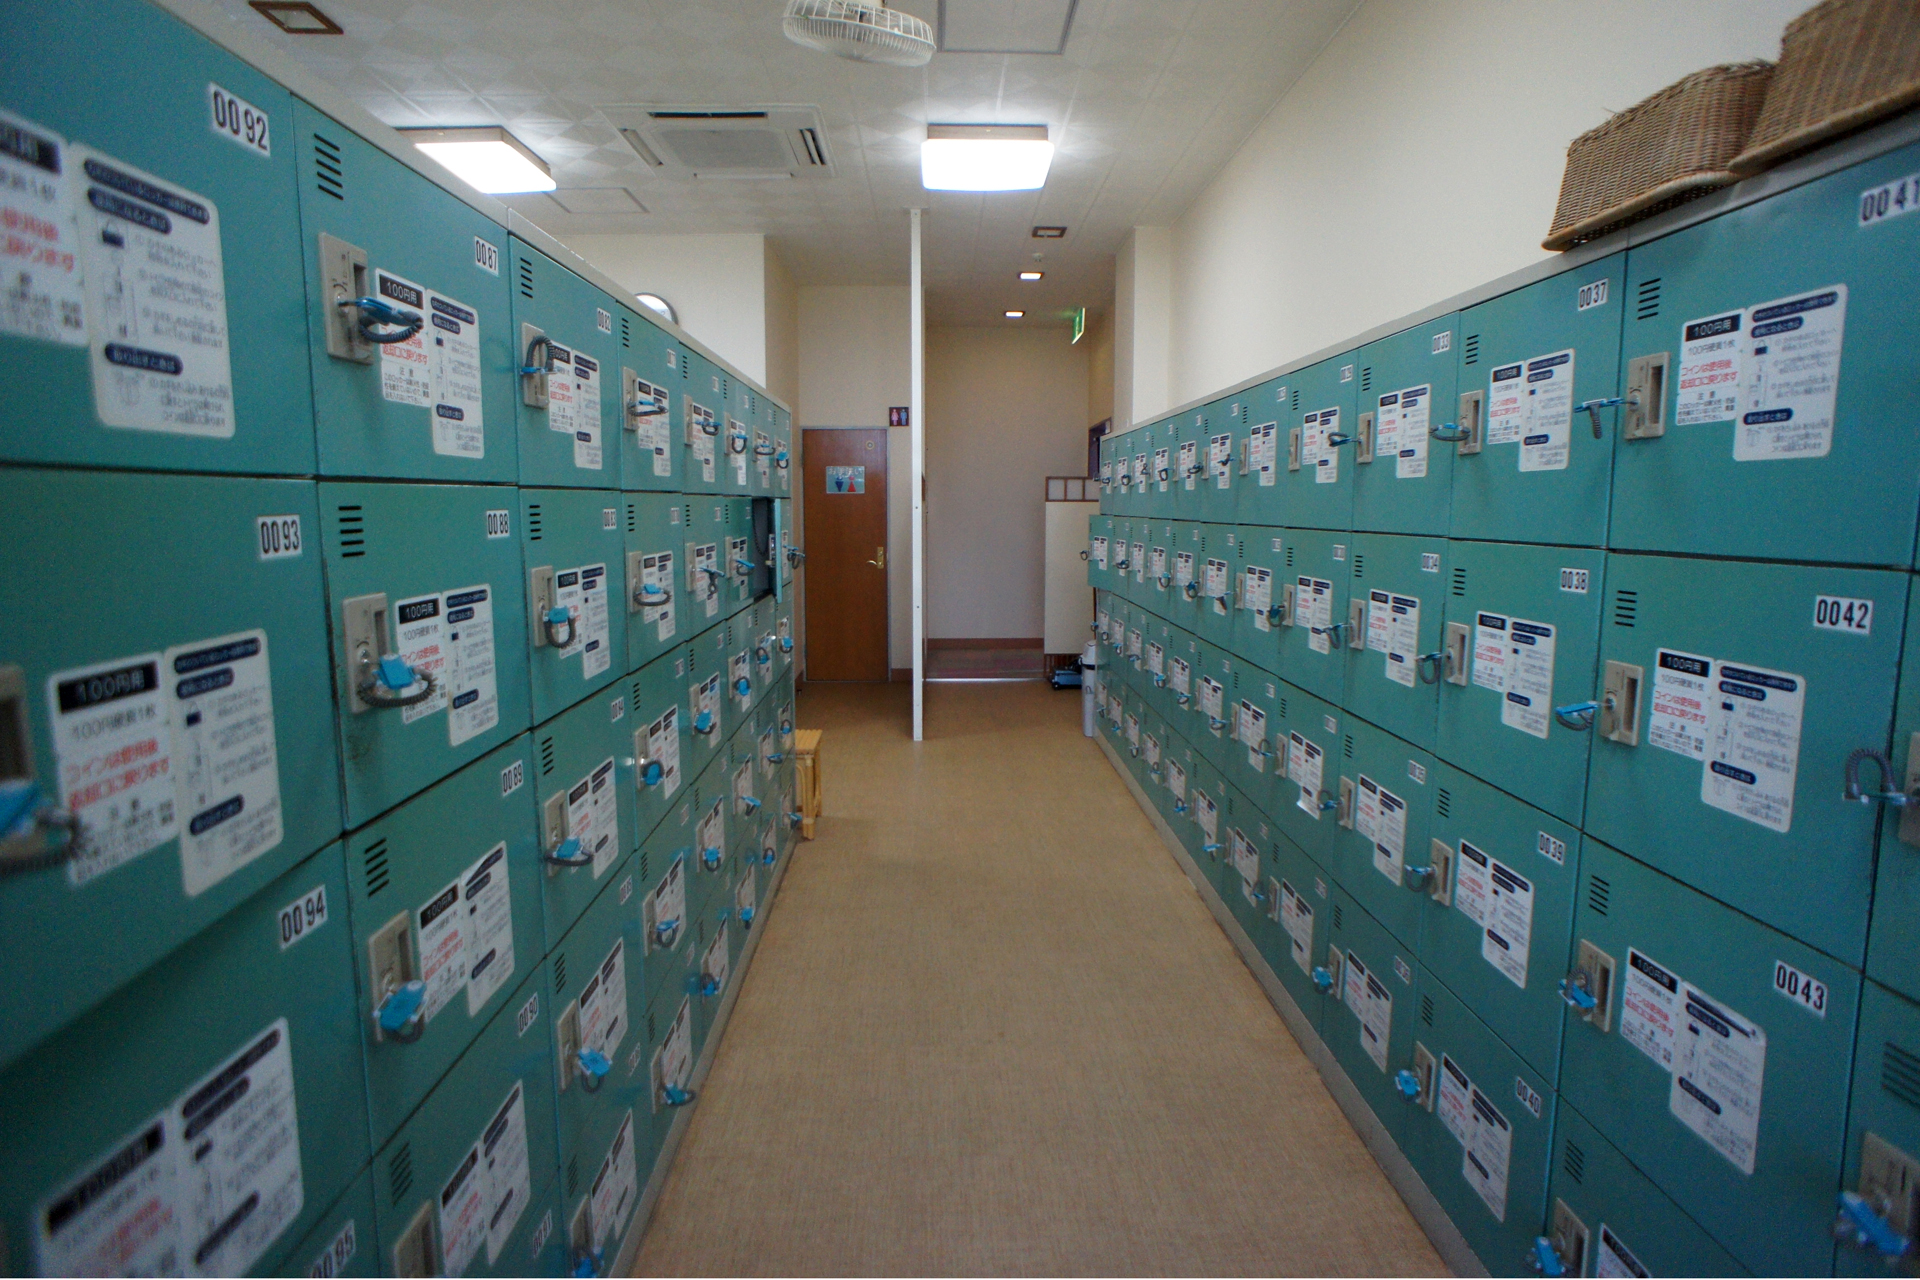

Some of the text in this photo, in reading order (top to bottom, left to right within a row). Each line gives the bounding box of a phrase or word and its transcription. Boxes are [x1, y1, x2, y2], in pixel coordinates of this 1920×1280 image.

[213, 90, 268, 150] 0092
[1862, 179, 1920, 221] 0041
[476, 240, 498, 271] 0087
[387, 281, 418, 304] 100円用
[1579, 282, 1607, 308] 0037
[1692, 319, 1732, 337] 100円用
[261, 520, 300, 555] 0093
[487, 513, 508, 536] 0088
[1561, 571, 1587, 591] 0038
[405, 602, 434, 619] 100円用
[1816, 599, 1870, 630] 0042
[1667, 656, 1702, 673] 100円用
[74, 669, 145, 703] 100円用
[503, 763, 523, 793] 0089
[1539, 833, 1563, 862] 0039
[281, 890, 326, 943] 0094
[1776, 963, 1824, 1011] 0043
[518, 995, 538, 1033] 0090
[1517, 1079, 1540, 1114] 0040
